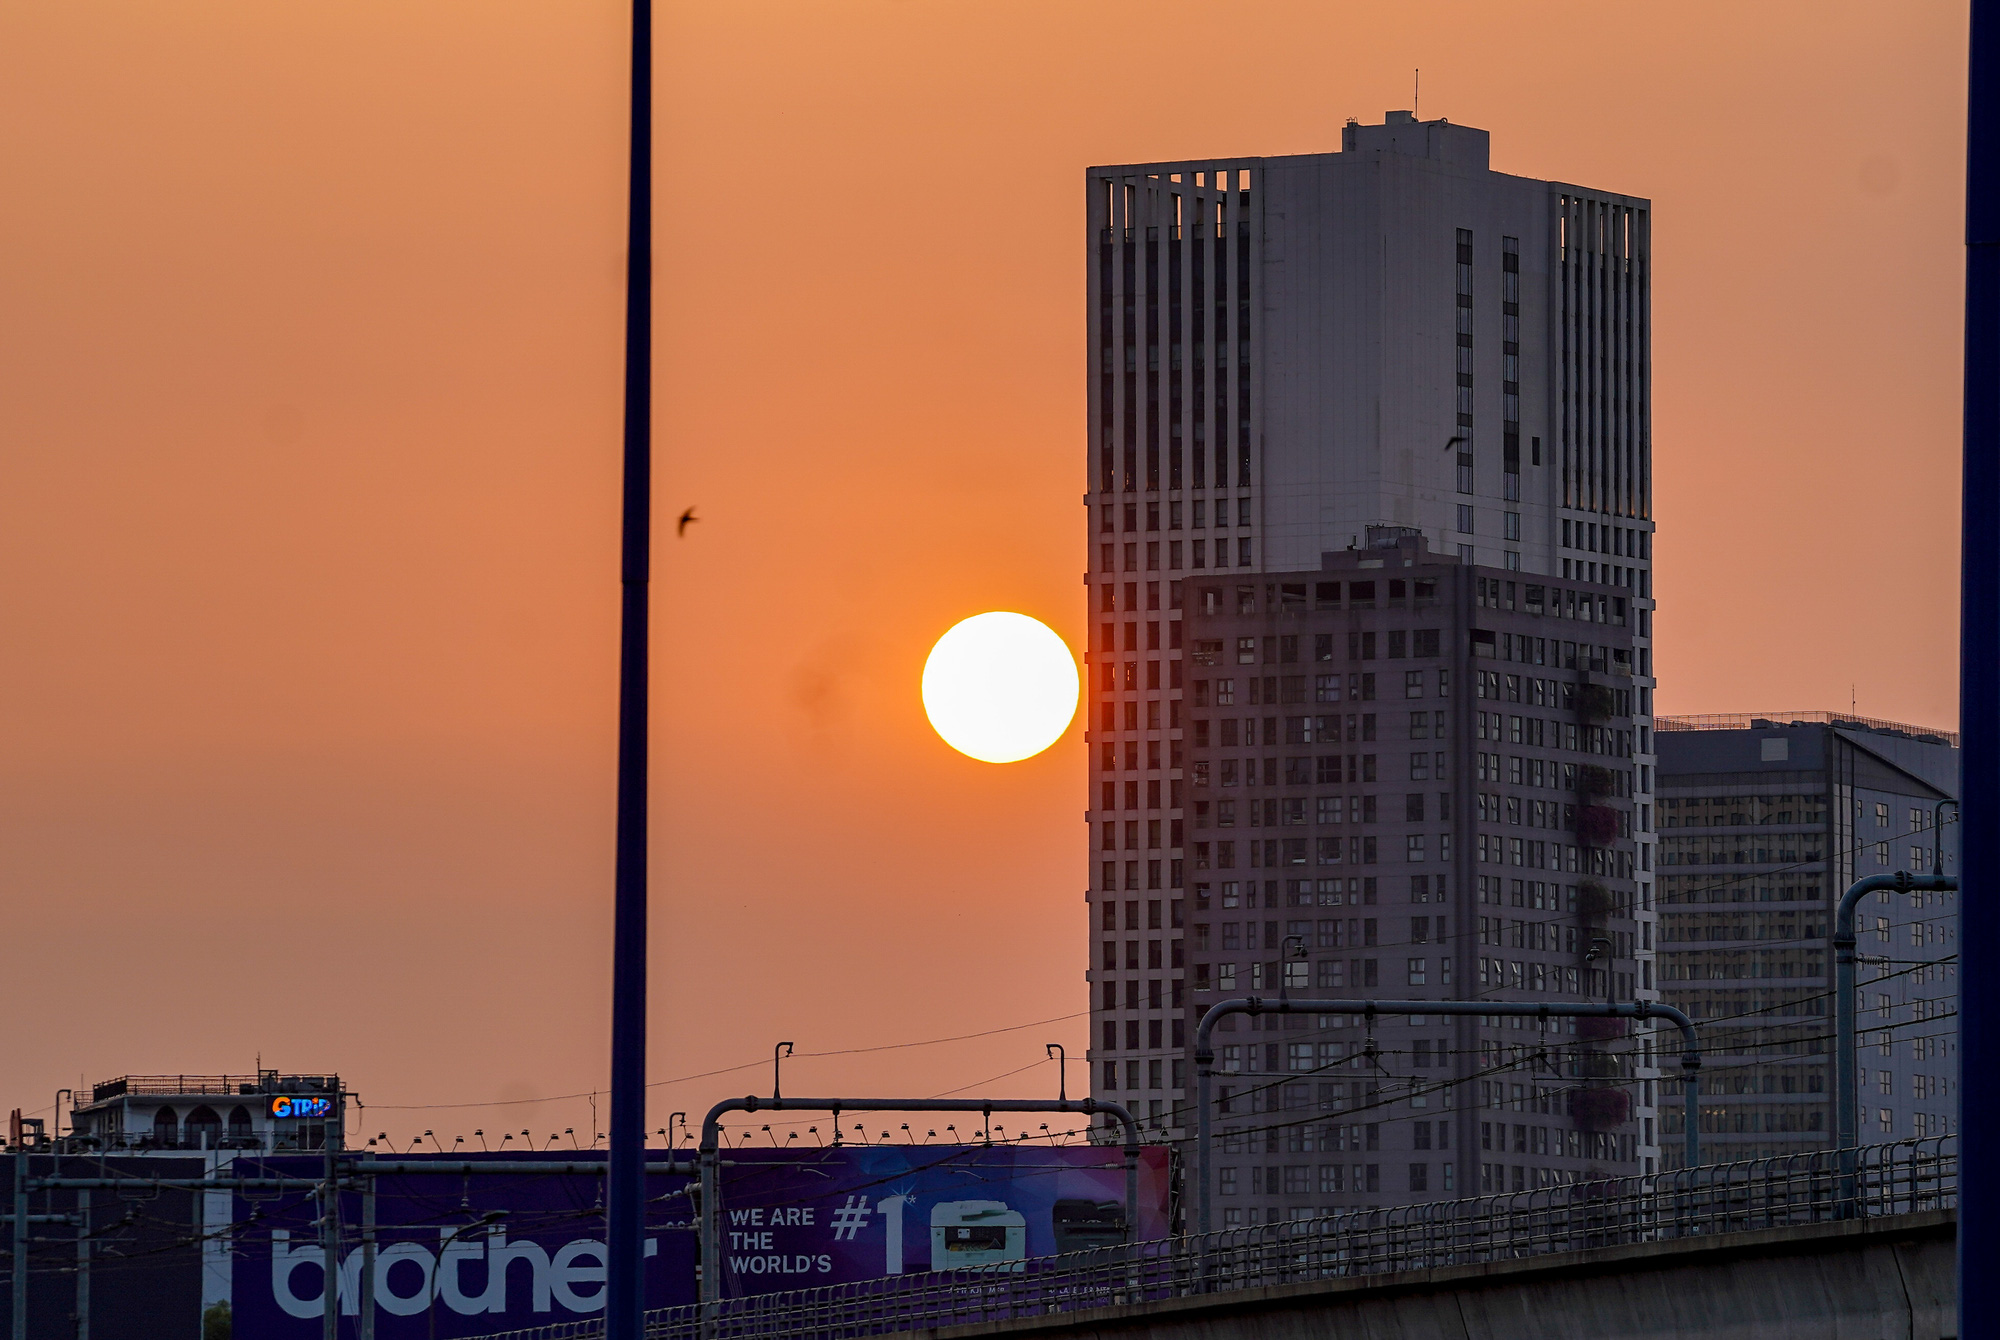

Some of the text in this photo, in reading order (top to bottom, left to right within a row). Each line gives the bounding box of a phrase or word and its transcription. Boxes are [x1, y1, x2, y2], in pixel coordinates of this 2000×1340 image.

[729, 1207, 815, 1226] WE ARE
[729, 1231, 774, 1250] THE
[272, 1225, 657, 1319] brothe
[729, 1254, 833, 1274] WORLD'S
